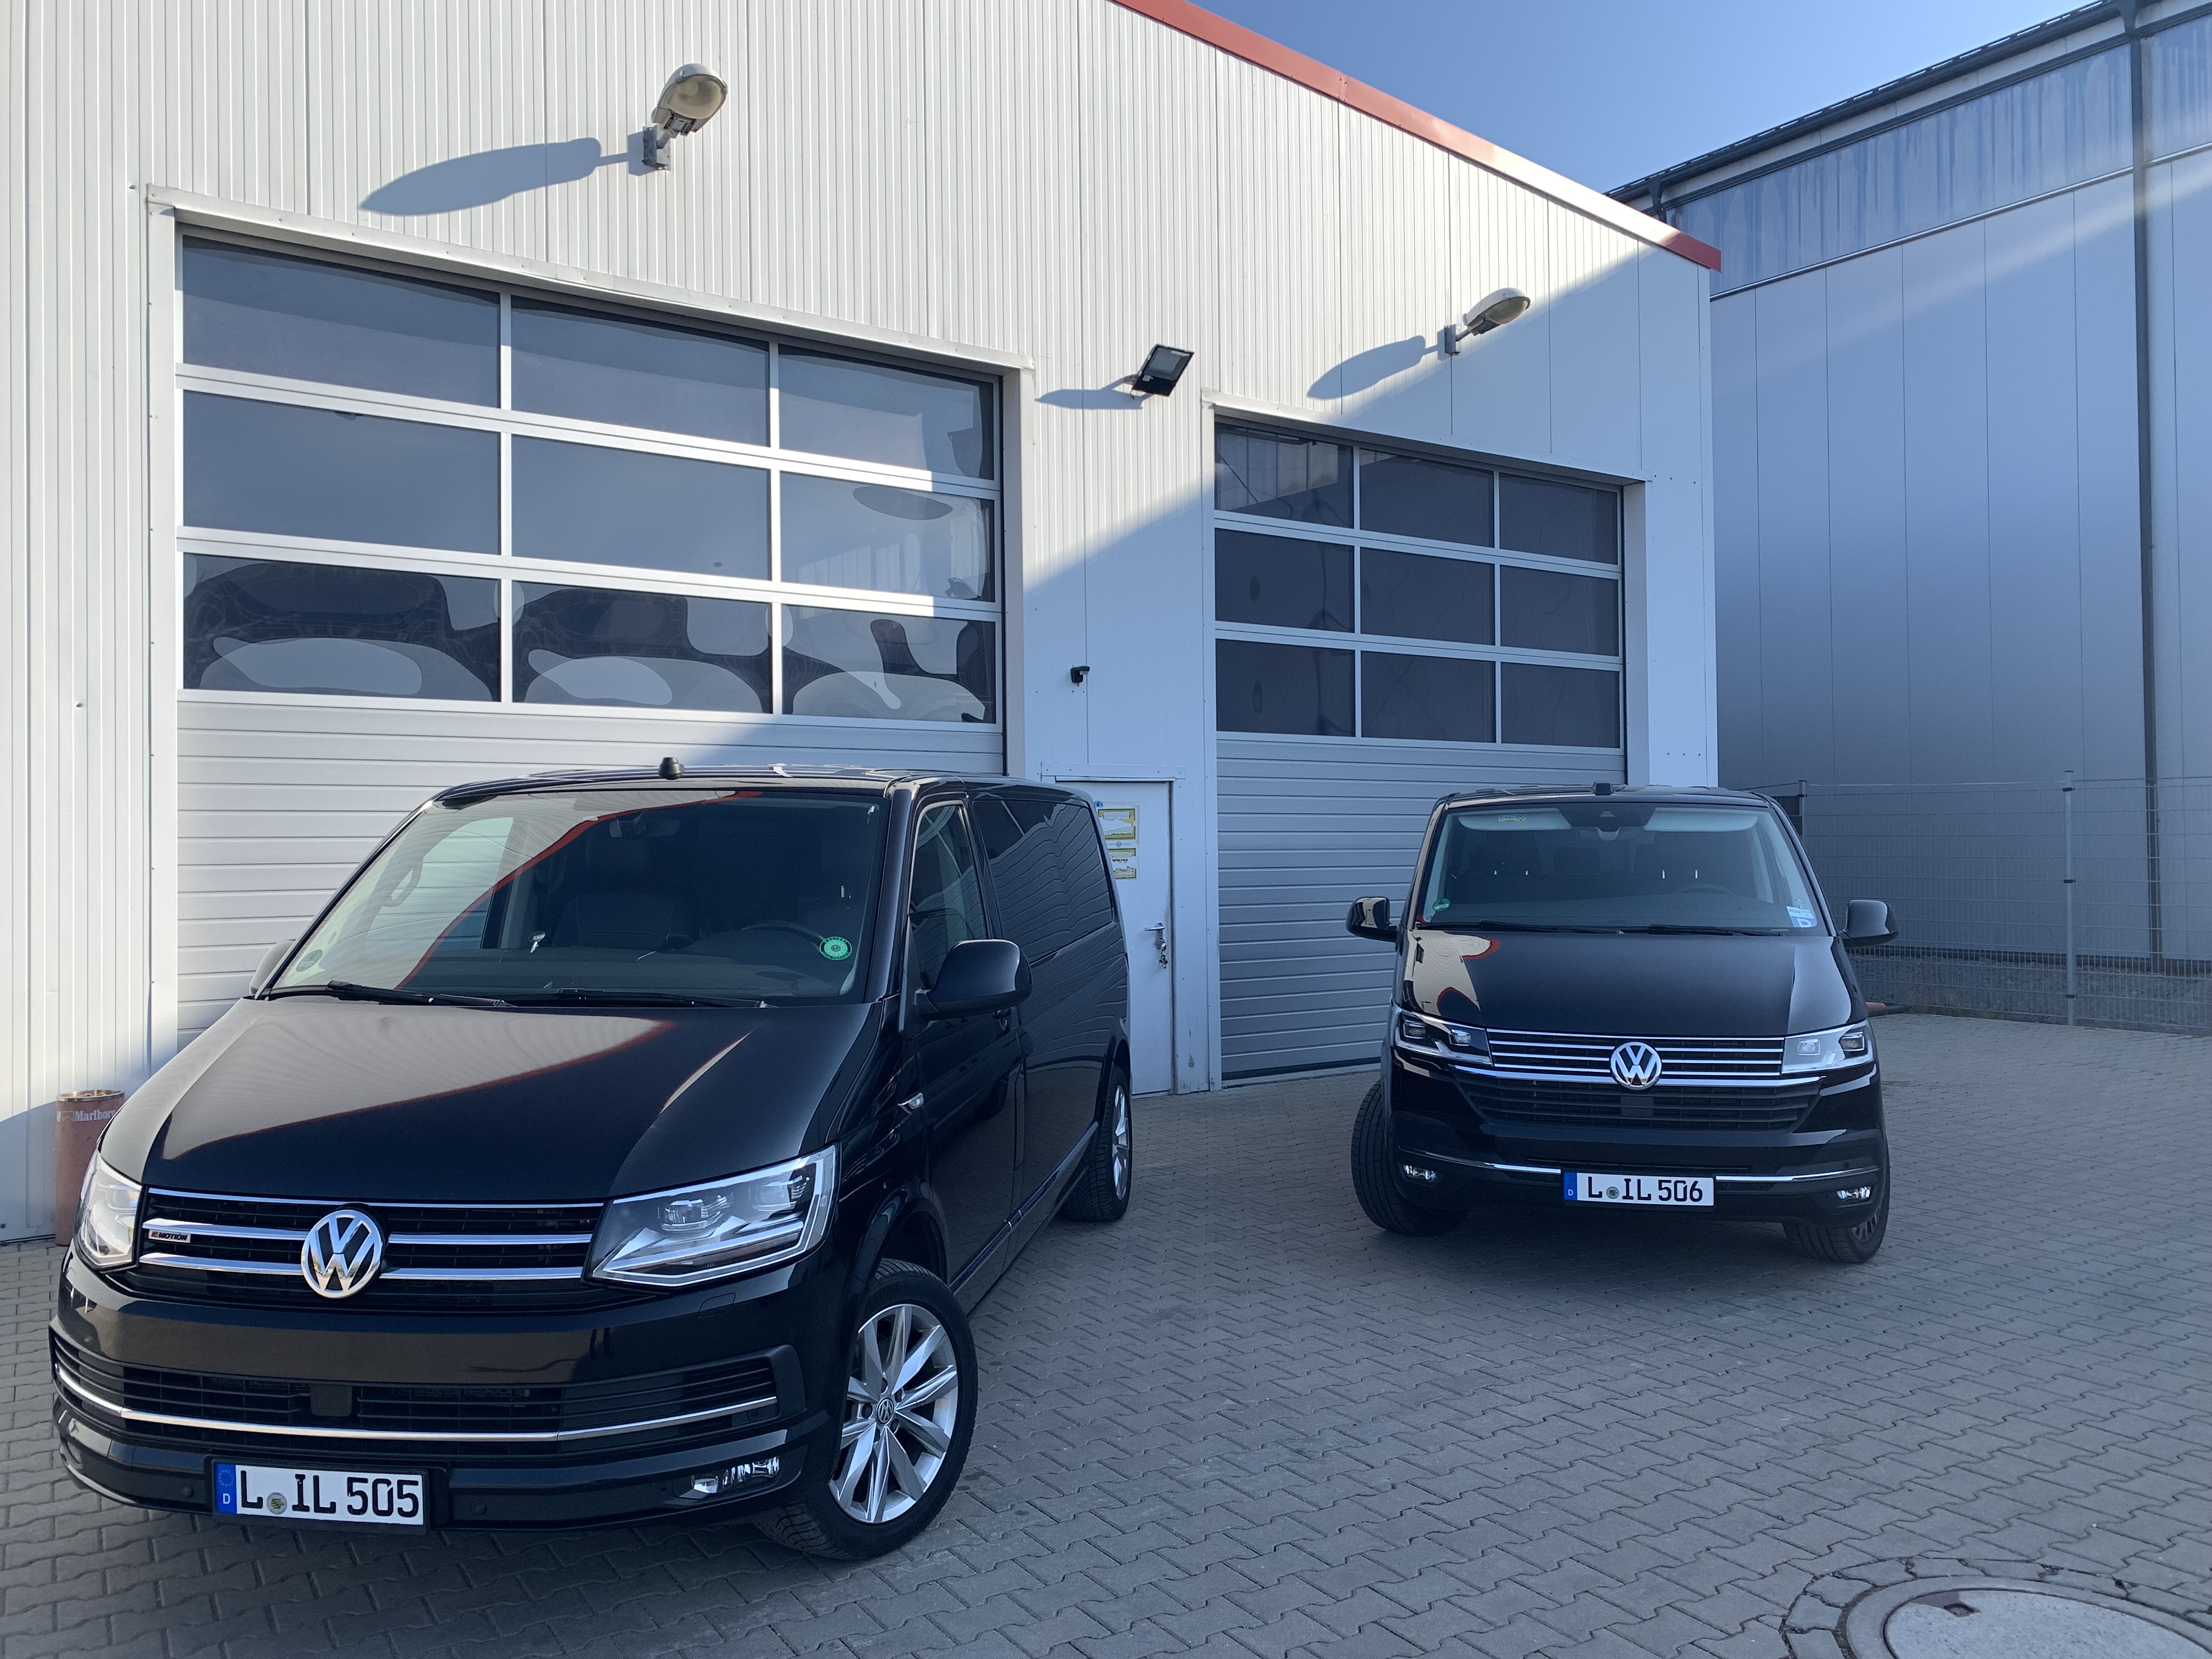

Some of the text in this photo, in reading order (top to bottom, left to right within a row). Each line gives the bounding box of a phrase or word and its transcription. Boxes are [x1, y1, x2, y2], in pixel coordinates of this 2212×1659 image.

[1611, 1042, 1661, 1090] VW
[75, 1109, 116, 1121] Marlboro
[1588, 1176, 1703, 1202] L IL 506
[302, 1210, 382, 1298] VW
[223, 1493, 230, 1504] D
[240, 1470, 419, 1518] L IL 505
